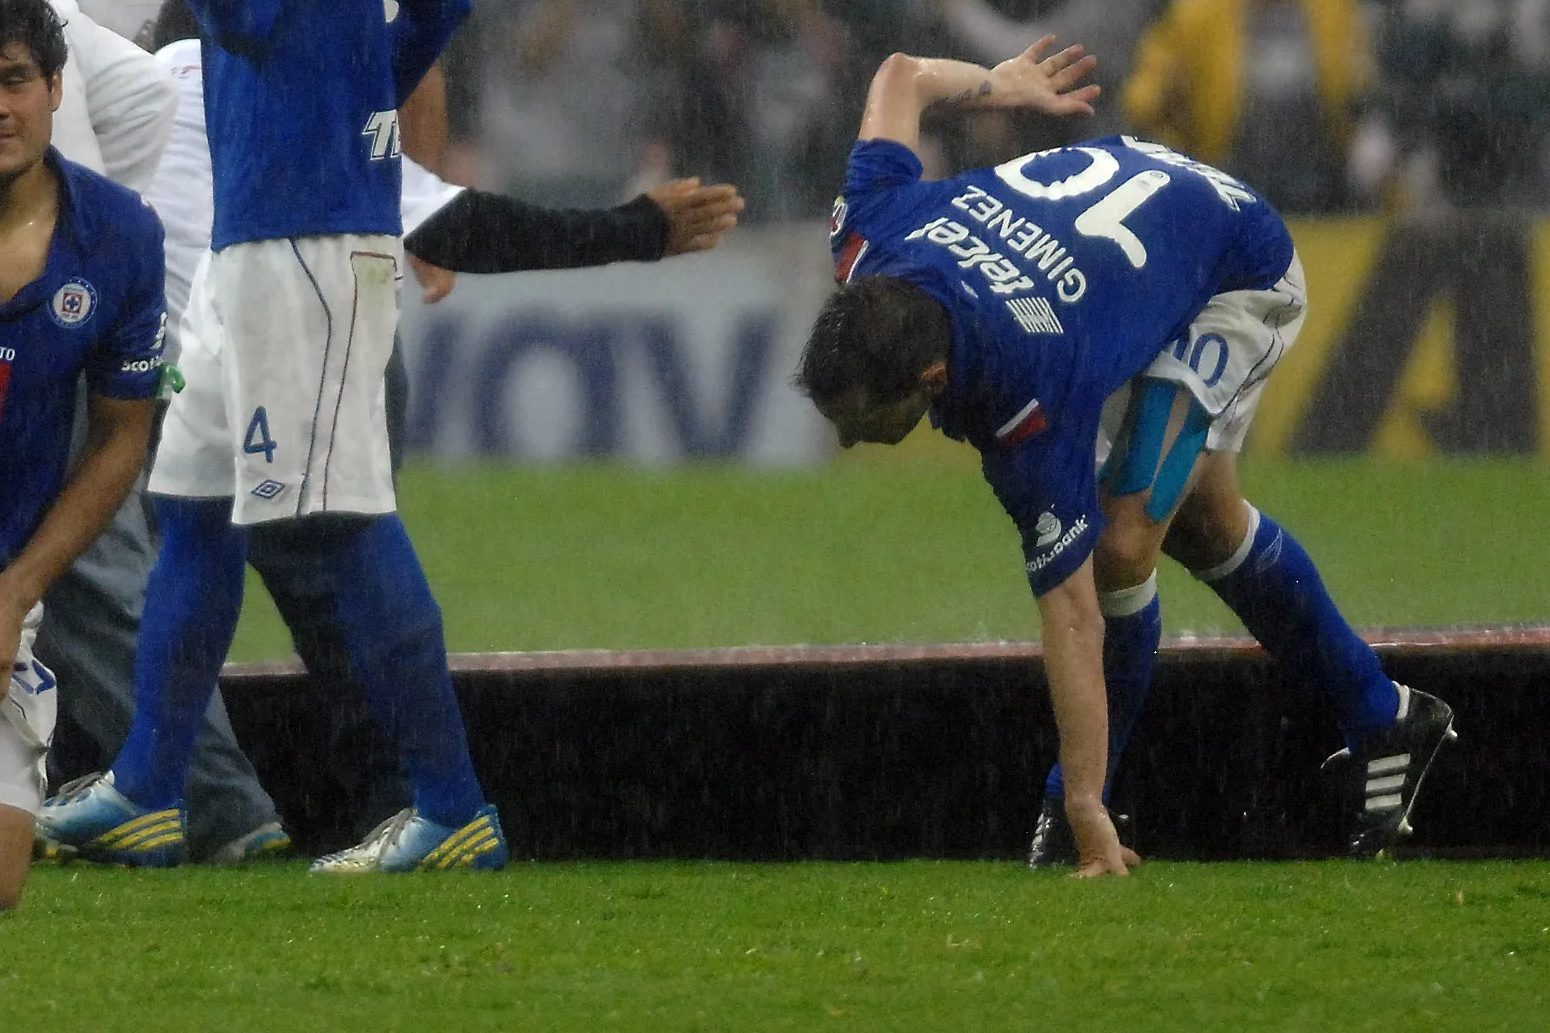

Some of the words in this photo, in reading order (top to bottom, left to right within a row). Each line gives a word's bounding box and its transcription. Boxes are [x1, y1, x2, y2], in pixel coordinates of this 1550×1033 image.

[904, 217, 1035, 295] telcel
[951, 185, 1088, 303] GIMENEZ
[994, 146, 1171, 269] 10
[243, 406, 278, 463] 4
